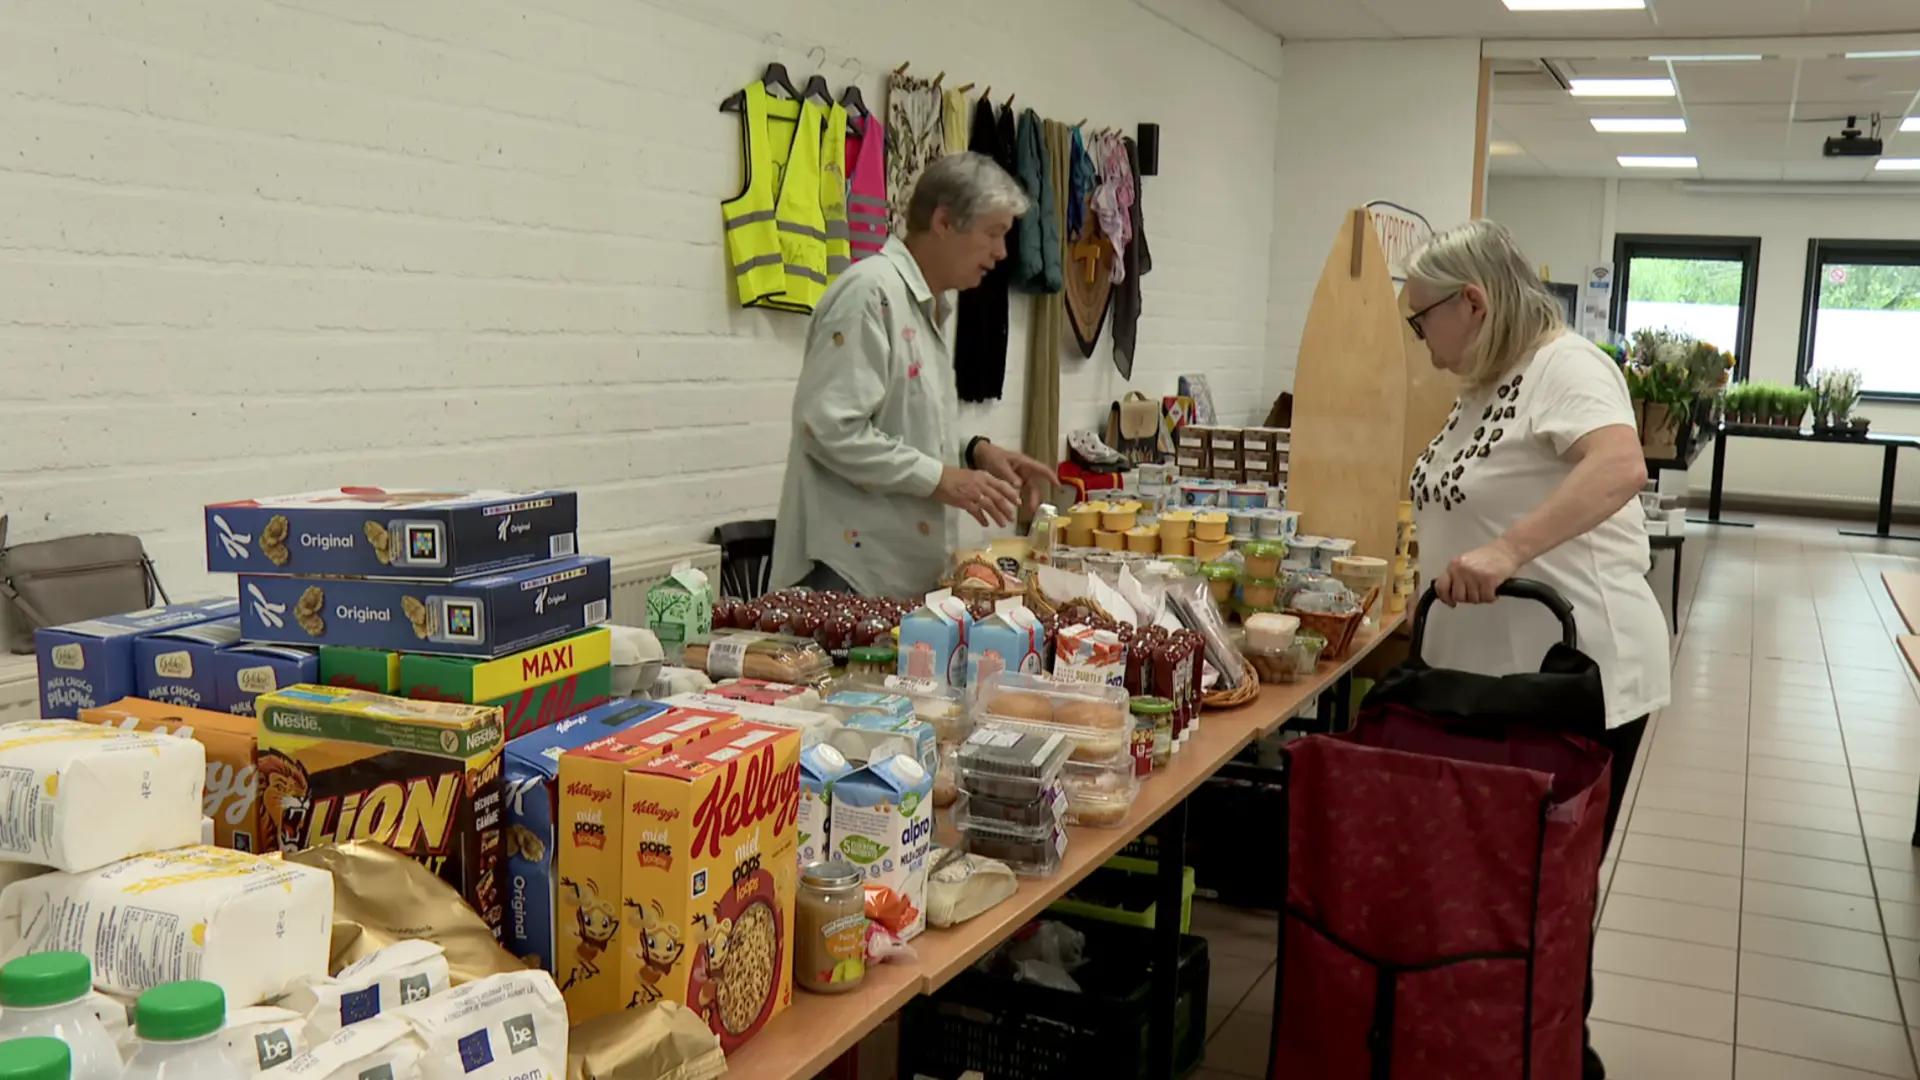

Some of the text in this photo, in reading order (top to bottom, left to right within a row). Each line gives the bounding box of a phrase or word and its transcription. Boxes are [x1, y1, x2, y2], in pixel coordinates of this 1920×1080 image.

[300, 533, 353, 551] Original
[336, 605, 390, 623] Original
[522, 644, 574, 681] MAXI
[47, 676, 93, 693] MILK CHOCO
[148, 685, 201, 702] MILK CHOCO
[230, 700, 252, 714] MILK
[476, 757, 501, 788] LION
[566, 780, 613, 802] Kellogg's
[475, 809, 499, 831] GAMME
[576, 807, 602, 821] miel
[632, 799, 680, 822] Kellogg's
[574, 822, 605, 836] pops
[642, 827, 668, 842] miel
[901, 817, 929, 847] alpro
[639, 841, 672, 856] pops
[735, 825, 760, 864] miel
[732, 852, 762, 888] pops
[512, 875, 527, 939] Original
